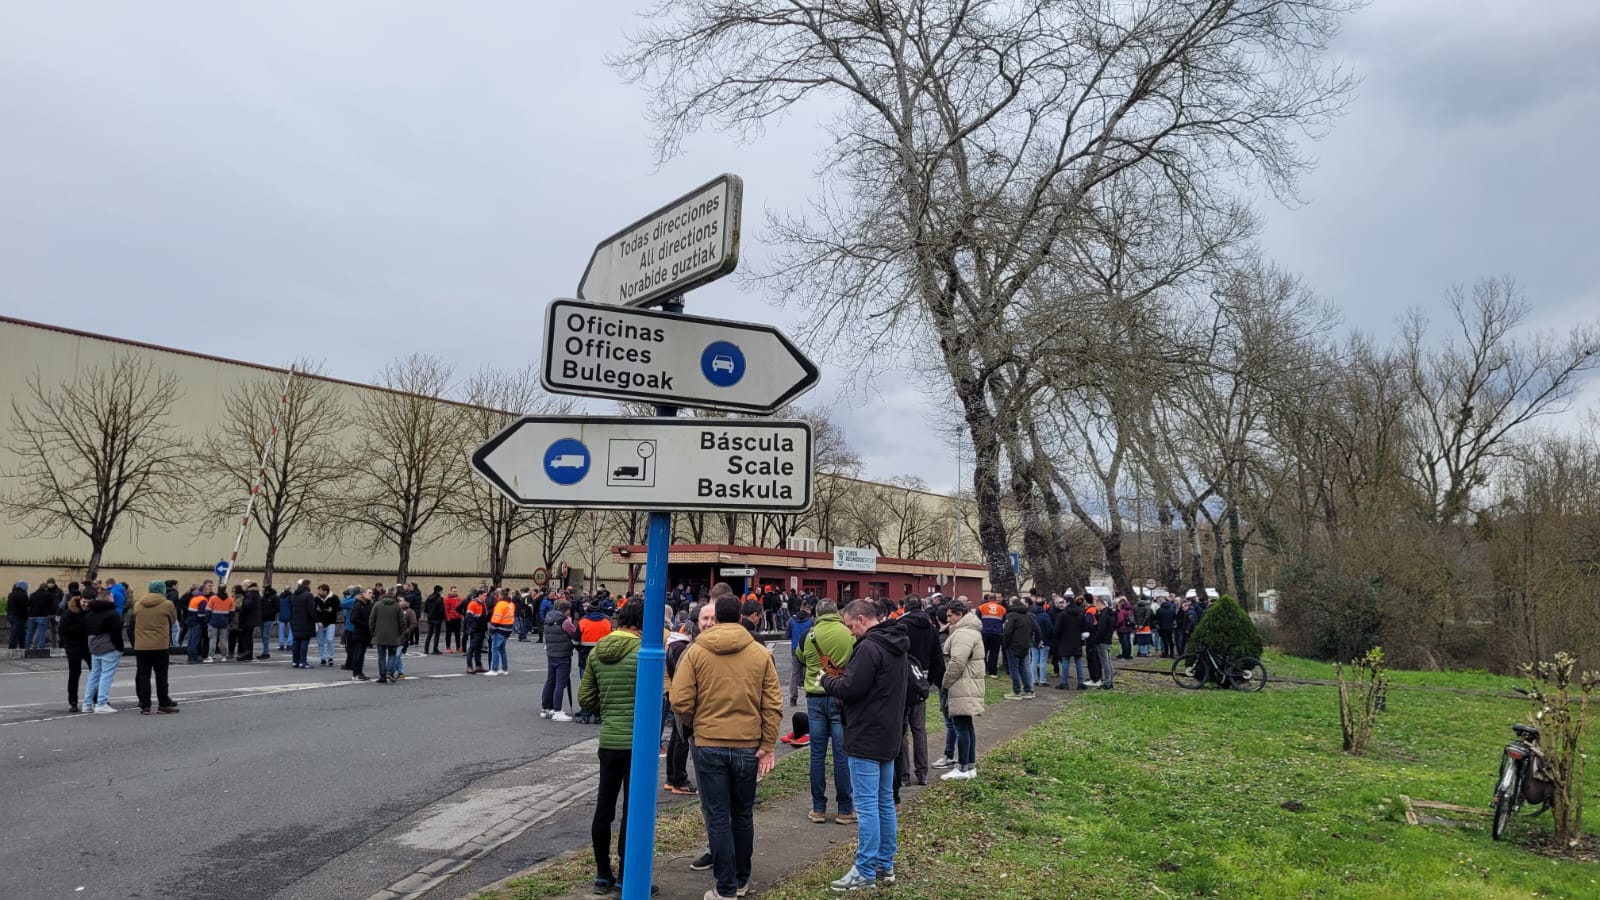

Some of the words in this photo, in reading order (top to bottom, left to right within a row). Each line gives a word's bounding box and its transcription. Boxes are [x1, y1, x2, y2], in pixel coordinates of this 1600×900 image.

[620, 232, 649, 259] Todas
[653, 195, 720, 241] direcciones
[640, 247, 654, 270] All
[659, 220, 718, 261] directions
[619, 265, 668, 301] Norabide
[672, 241, 717, 281] guztiak
[566, 313, 665, 343] Oficinas
[564, 336, 652, 364] Offices
[562, 360, 674, 391] Bulegoak
[700, 431, 794, 452] Báscula
[727, 456, 794, 476] Scale
[697, 478, 793, 499] Baskula
